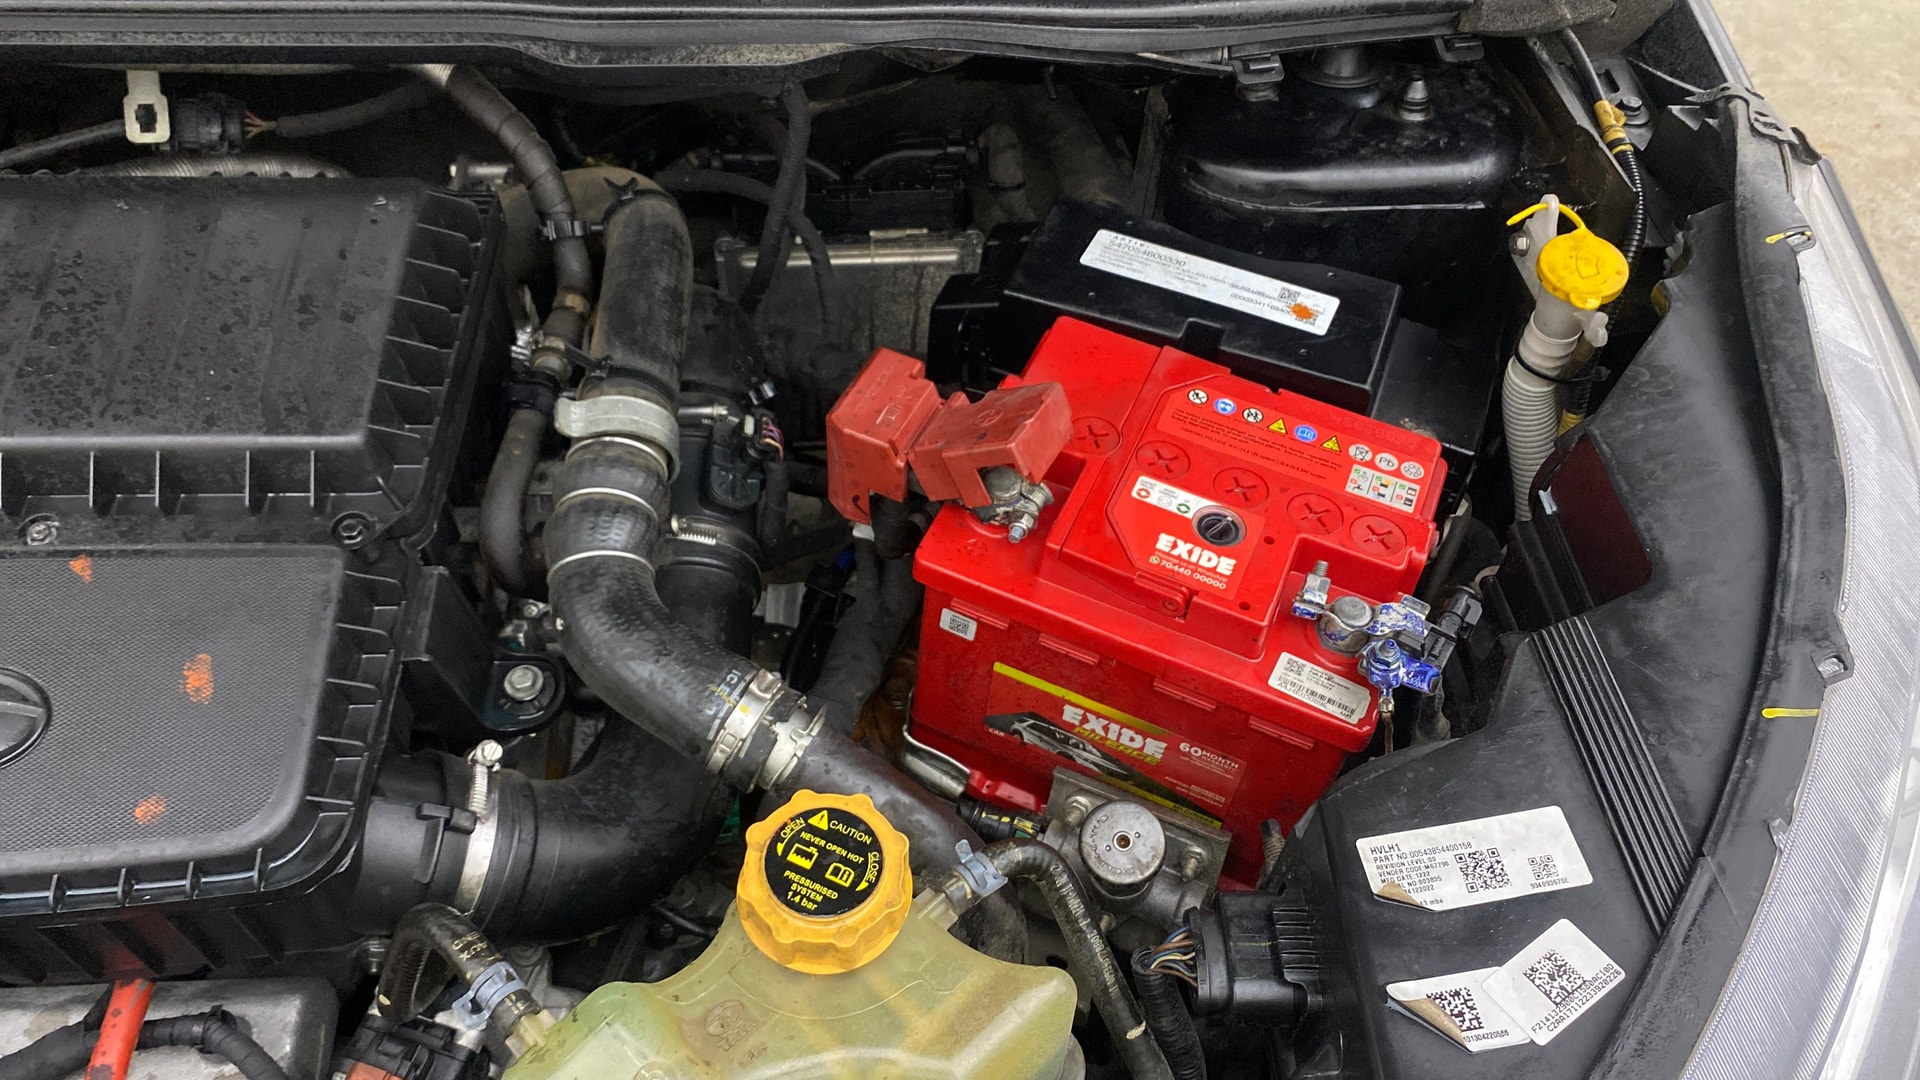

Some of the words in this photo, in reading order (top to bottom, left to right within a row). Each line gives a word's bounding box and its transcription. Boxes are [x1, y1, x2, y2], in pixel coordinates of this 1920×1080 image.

[1378, 456, 1395, 468] Pb
[1155, 533, 1237, 576] EXIDE
[1158, 559, 1192, 576] 70440
[1191, 572, 1227, 590] 00000
[988, 727, 1006, 738] CAR
[1062, 704, 1168, 760] EXIDE
[1072, 725, 1161, 767] MILEAGE
[1179, 742, 1201, 757] 60
[1202, 750, 1239, 769] MONTH
[780, 817, 805, 838] OPEN
[829, 820, 872, 845] CAUTION
[800, 832, 825, 847] NEVER
[826, 842, 848, 856] OPEN
[848, 852, 865, 864] HOT
[1369, 843, 1401, 856] HVLH1
[1373, 853, 1394, 865] PART
[869, 851, 879, 883] CLOSE
[1376, 860, 1403, 871] REVISION
[1378, 866, 1405, 878] VENDER
[784, 870, 838, 900] PRESSURISED
[790, 884, 823, 902] SYSTEM
[787, 891, 801, 903] 1.4
[801, 897, 818, 911] bar
